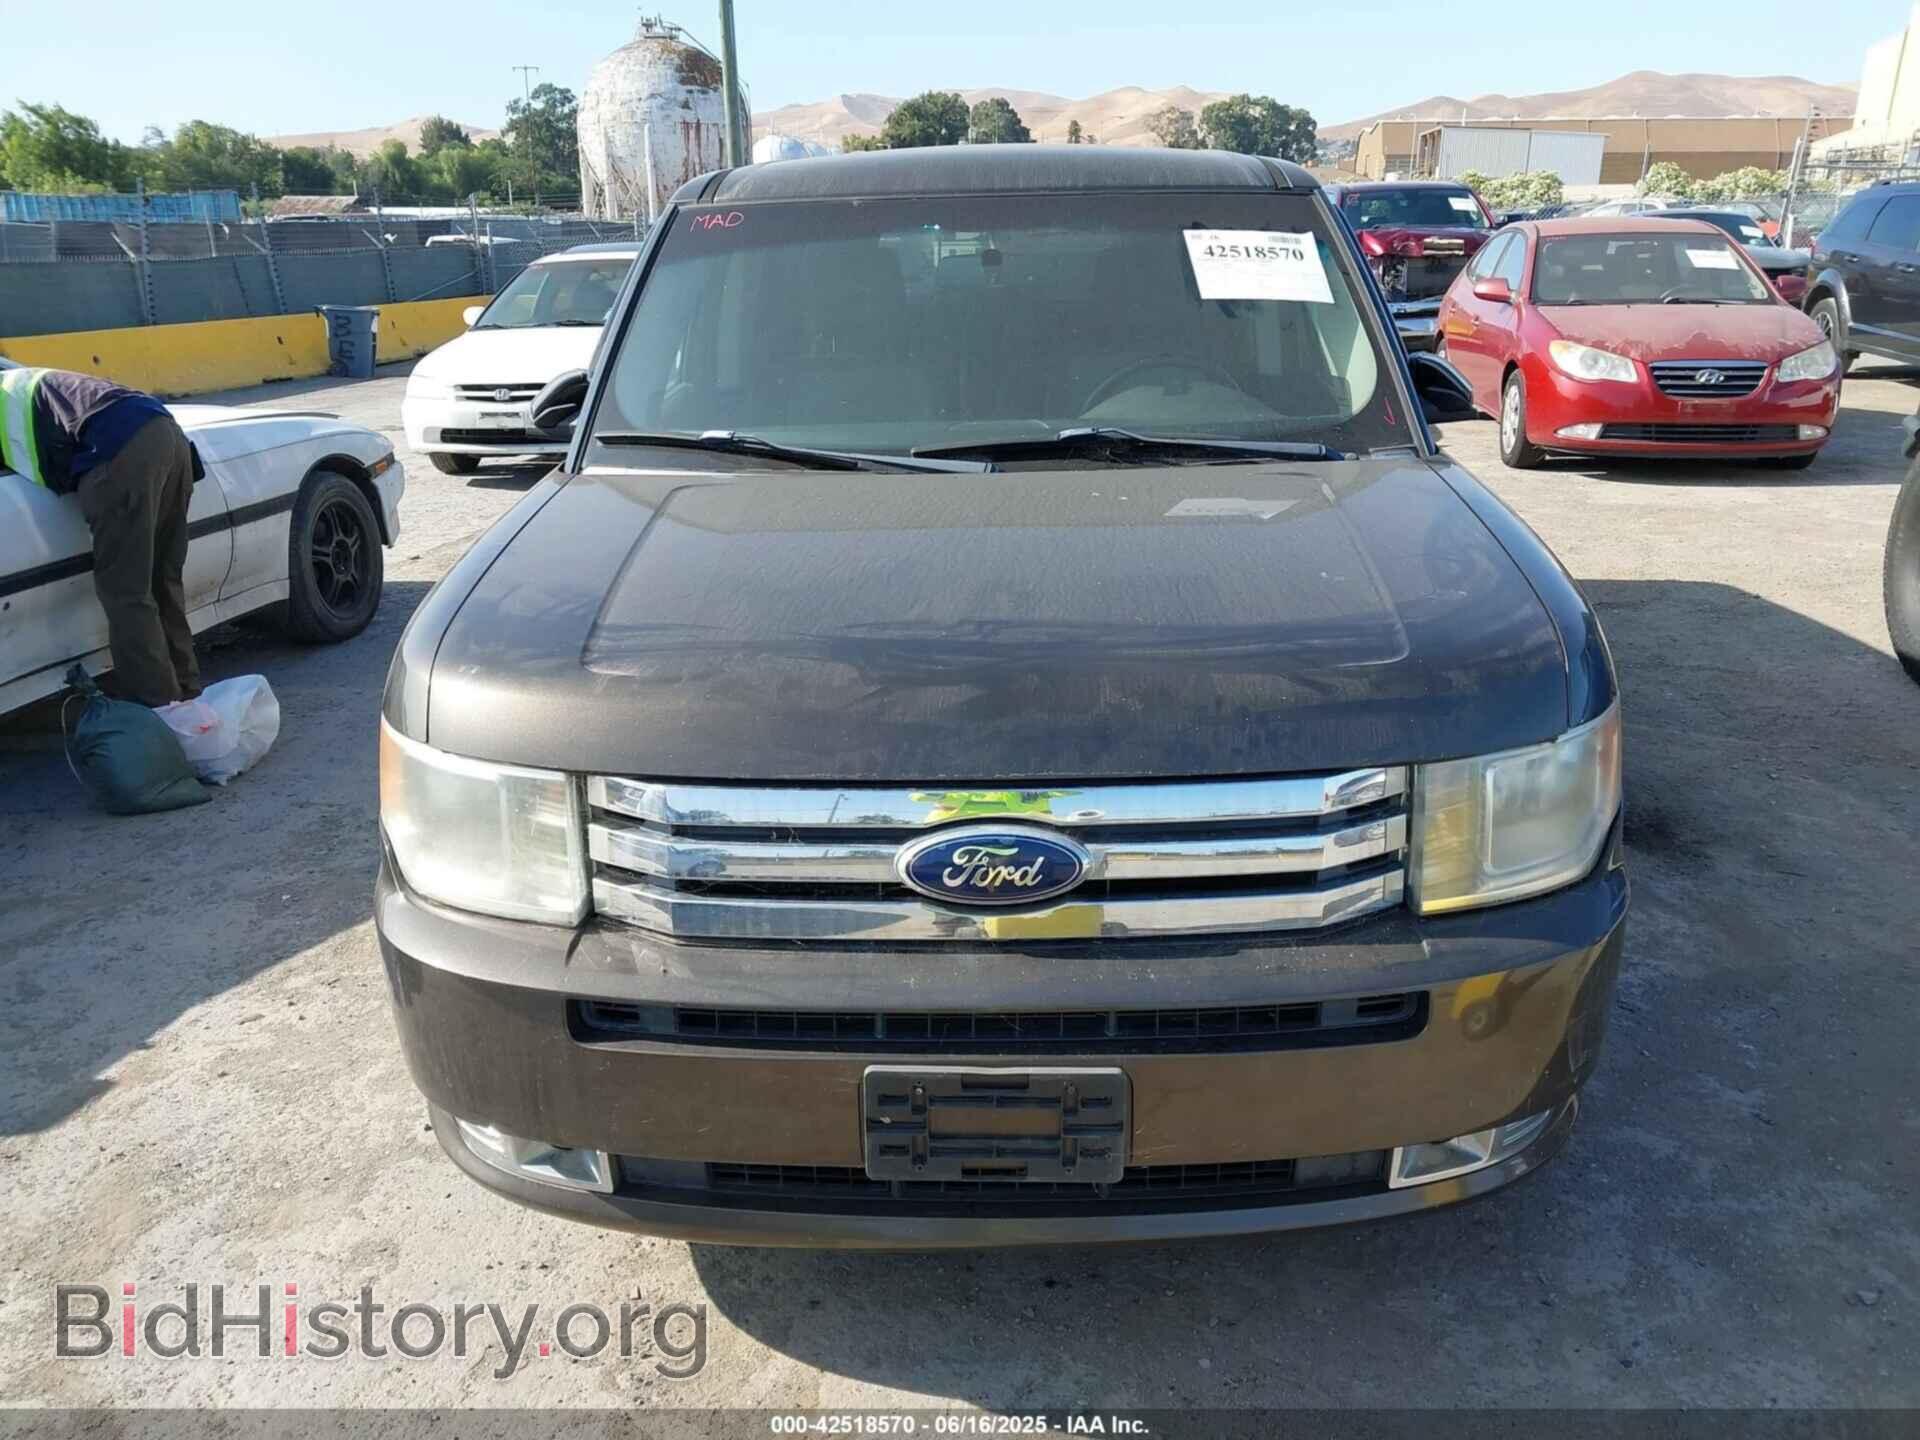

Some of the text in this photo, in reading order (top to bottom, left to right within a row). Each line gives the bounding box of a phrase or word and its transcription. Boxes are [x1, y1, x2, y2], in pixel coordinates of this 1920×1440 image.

[689, 211, 745, 233] MAD
[1203, 244, 1305, 261] 42518570
[942, 845, 1045, 888] Ford
